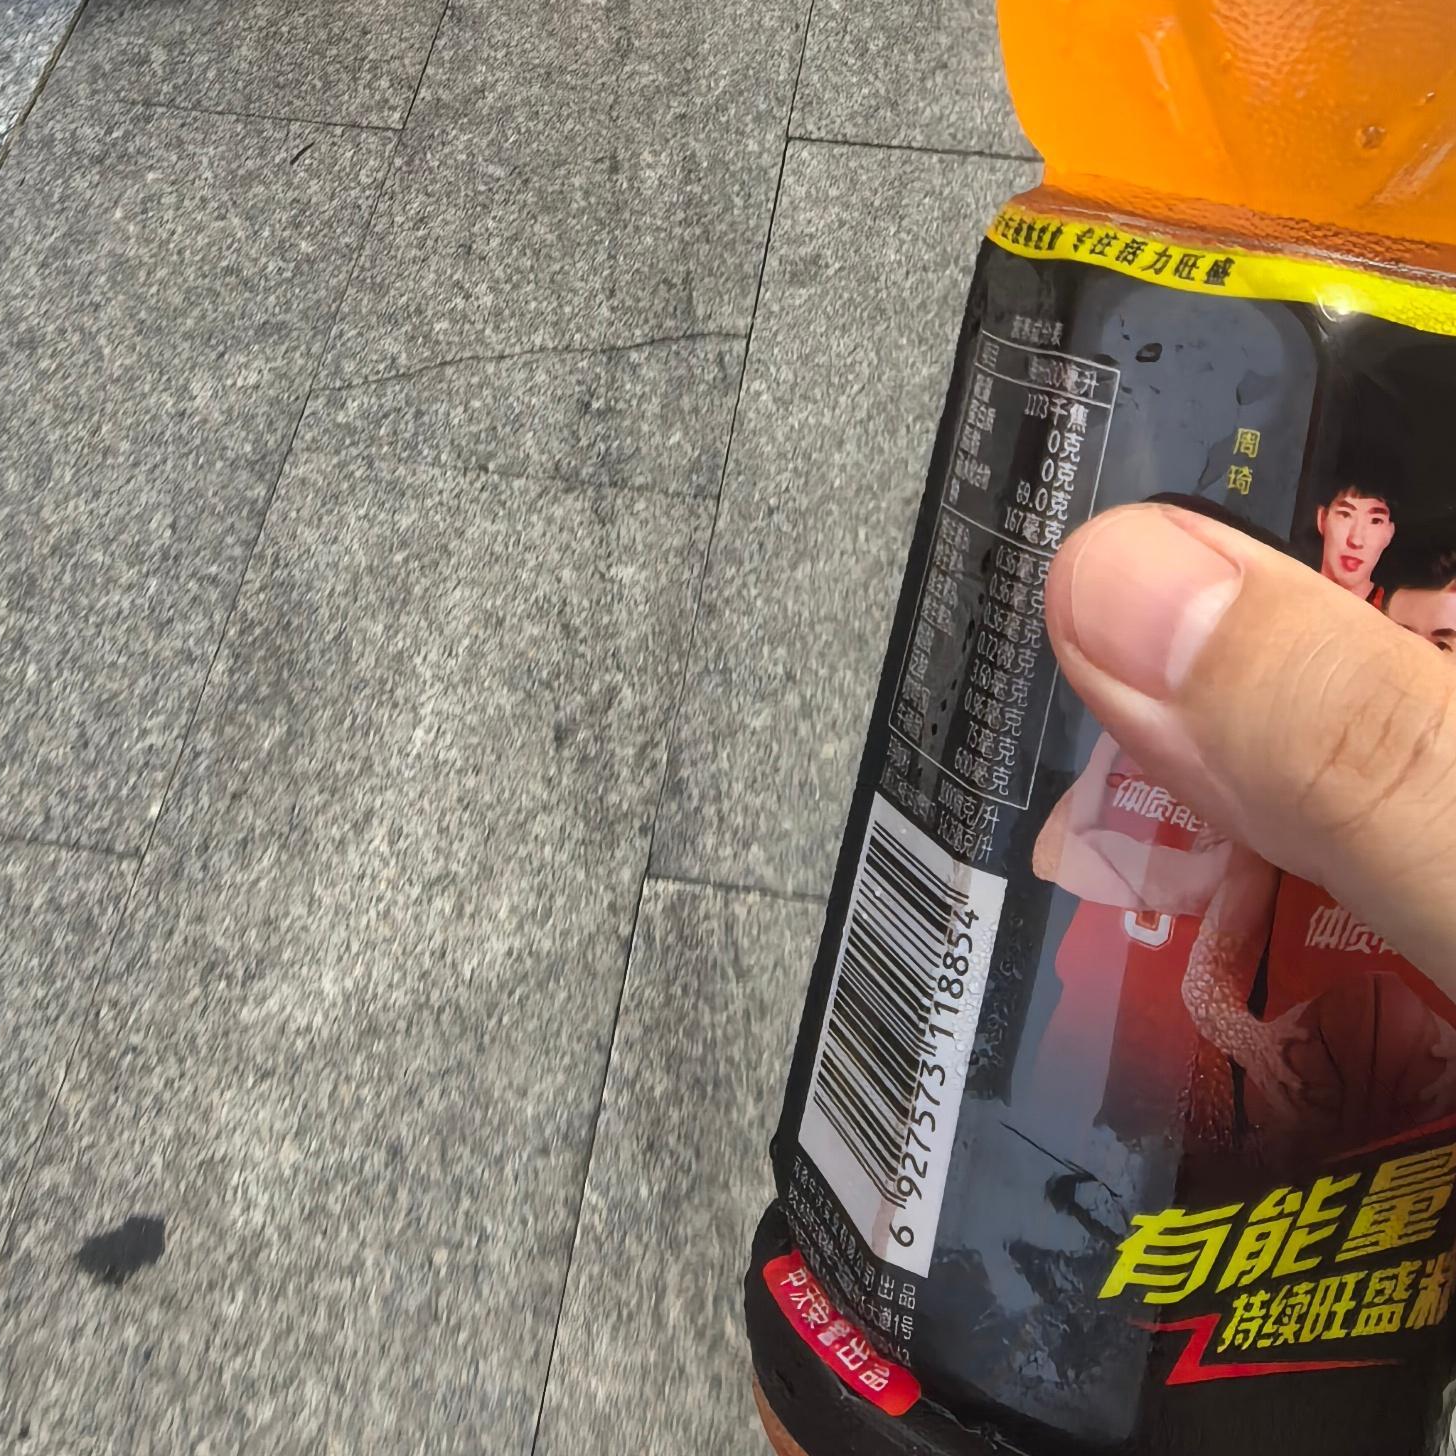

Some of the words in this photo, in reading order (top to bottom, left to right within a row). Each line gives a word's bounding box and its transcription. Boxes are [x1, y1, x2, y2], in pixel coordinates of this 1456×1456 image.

[1228, 427, 1261, 495] 周琦
[928, 907, 979, 1040] 118854
[897, 1062, 947, 1200] 927573
[888, 1224, 915, 1249] 6
